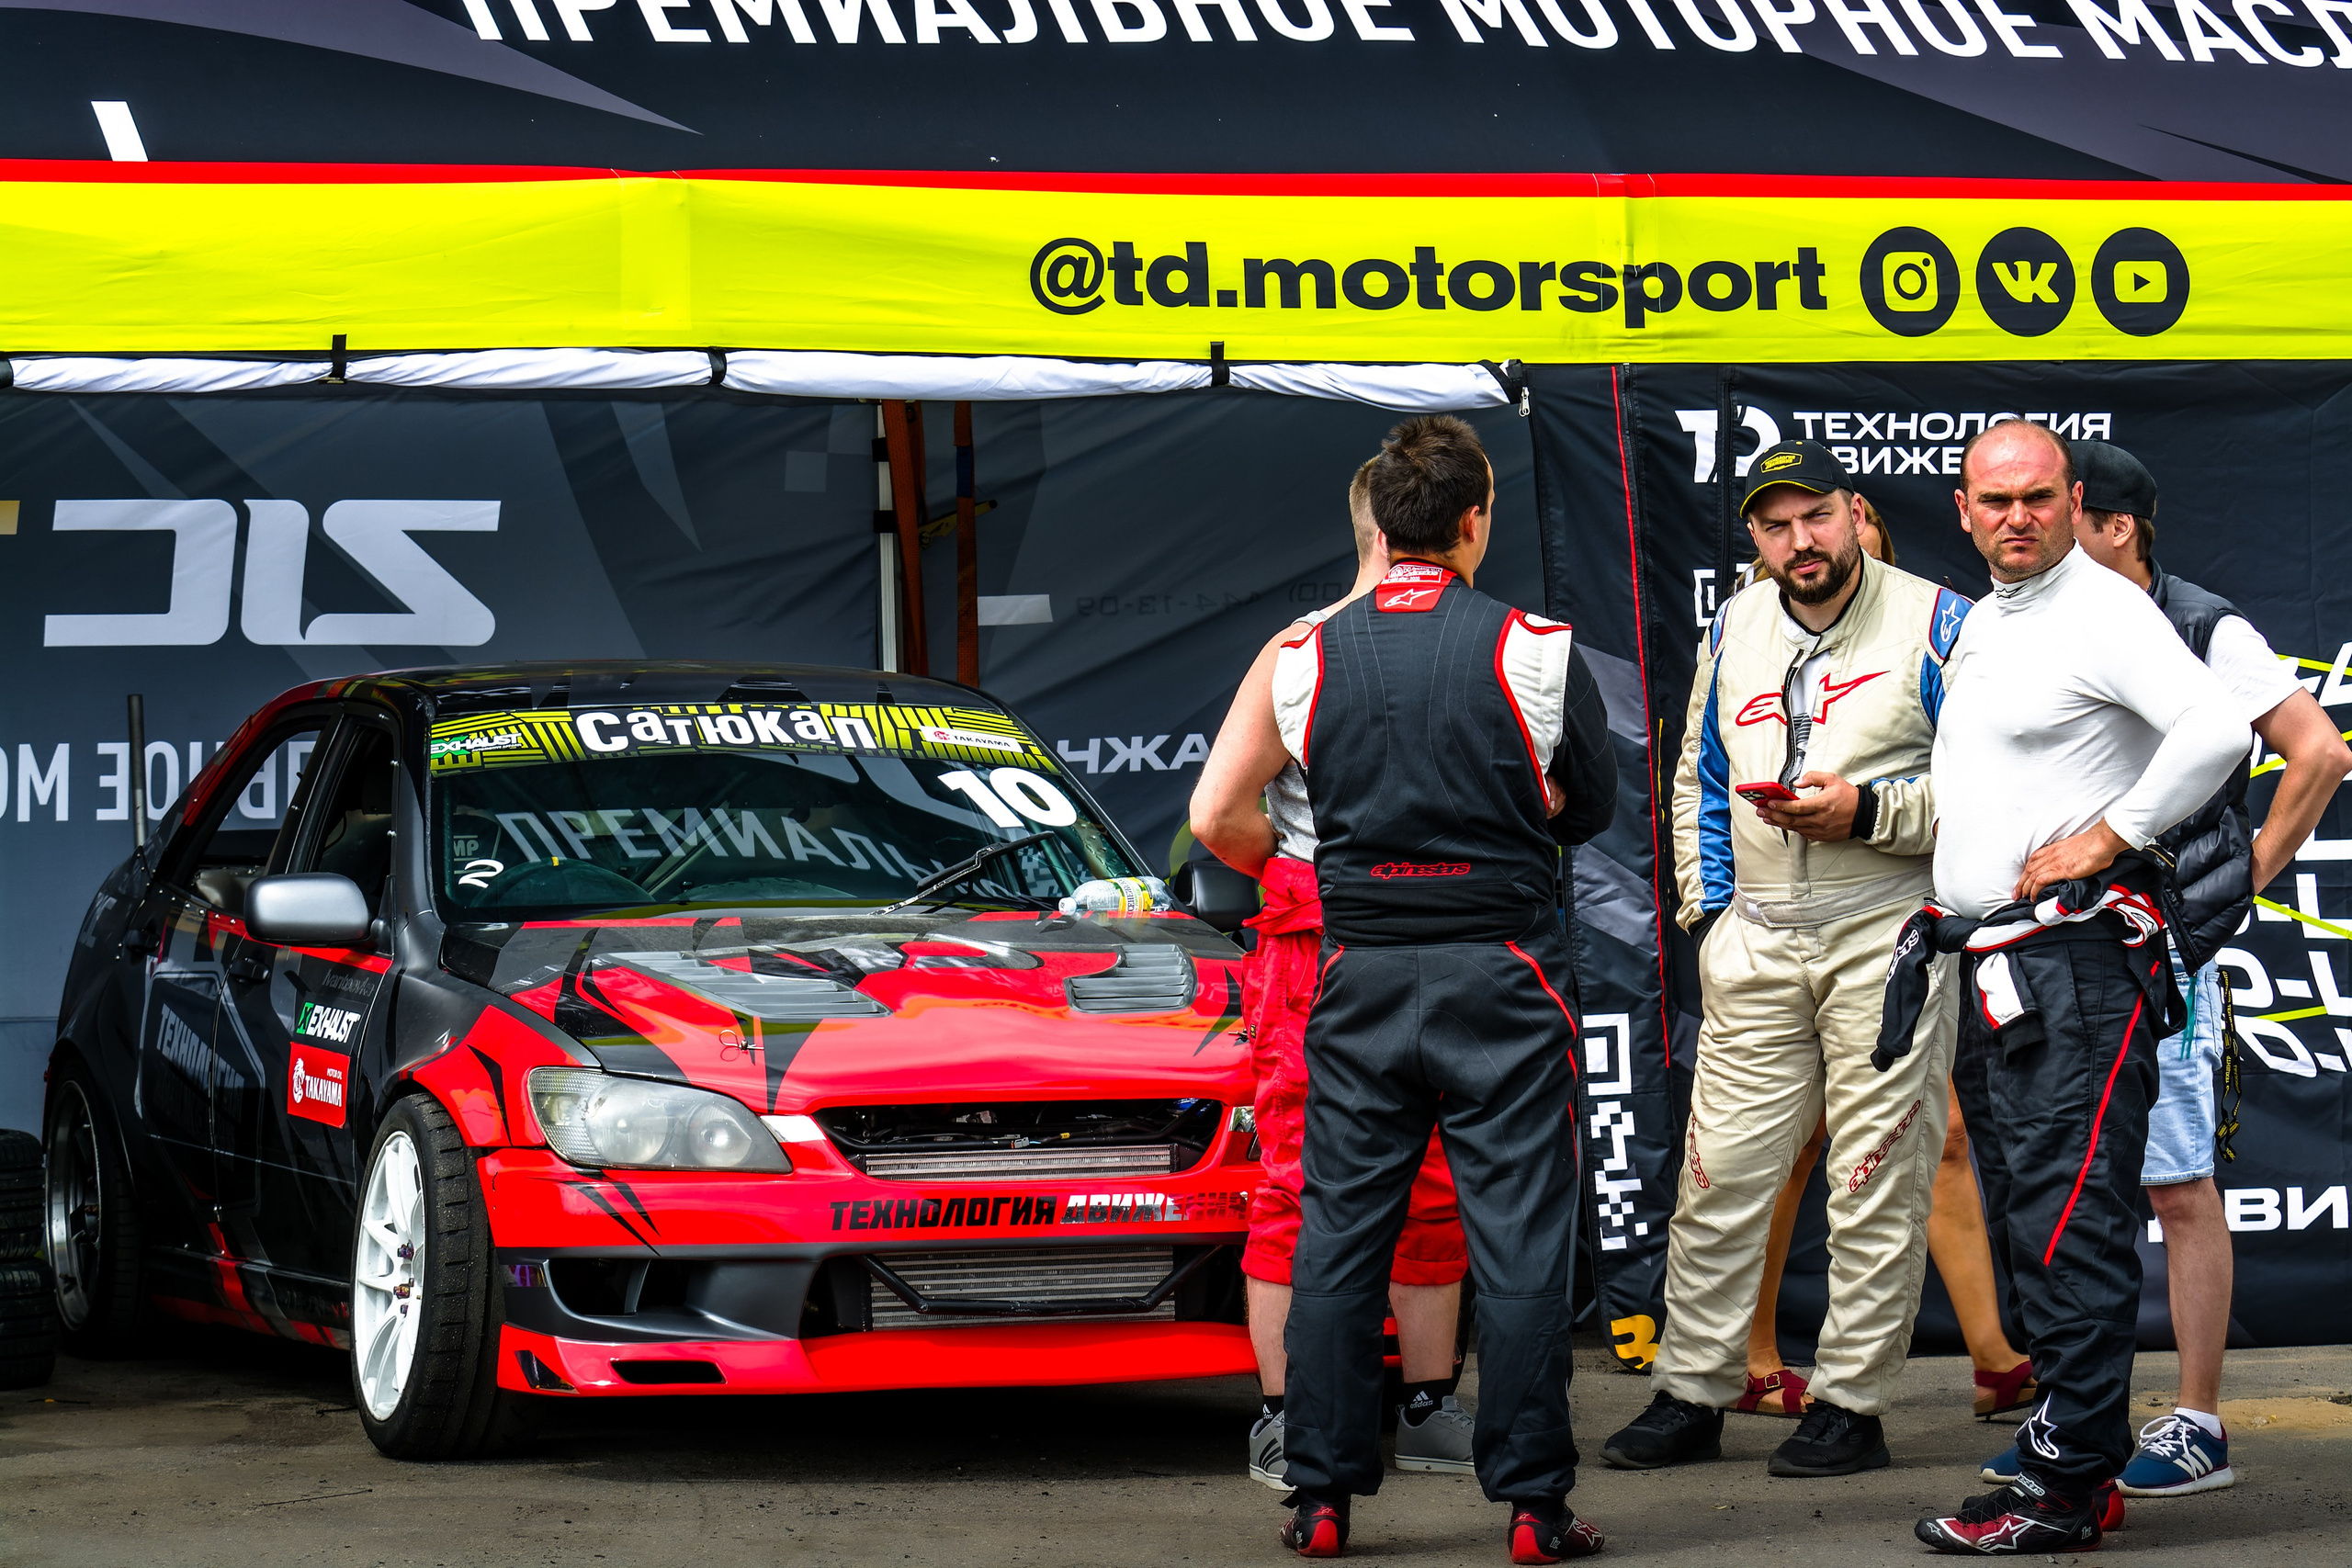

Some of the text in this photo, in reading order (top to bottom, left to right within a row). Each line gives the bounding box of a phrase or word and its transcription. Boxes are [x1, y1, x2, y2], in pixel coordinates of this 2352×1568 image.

[462, 0, 1416, 45] ПРЕМИАЛЬНОЕ
[1451, 0, 2063, 59] МОТОРНОЕ
[1030, 237, 1828, 329] @td.motorsport
[1792, 411, 2112, 441] ТЕХНОЛИЯ
[937, 767, 1078, 829] 10
[1370, 862, 1471, 880] alpinestars
[305, 1004, 362, 1043] EXHAUST
[305, 1075, 343, 1108] TAKAYAMA
[1849, 1100, 1921, 1193] alpinestars
[830, 1196, 1057, 1231] ТЕХНОЛОГИЯ
[1409, 1400, 1433, 1409] adidas
